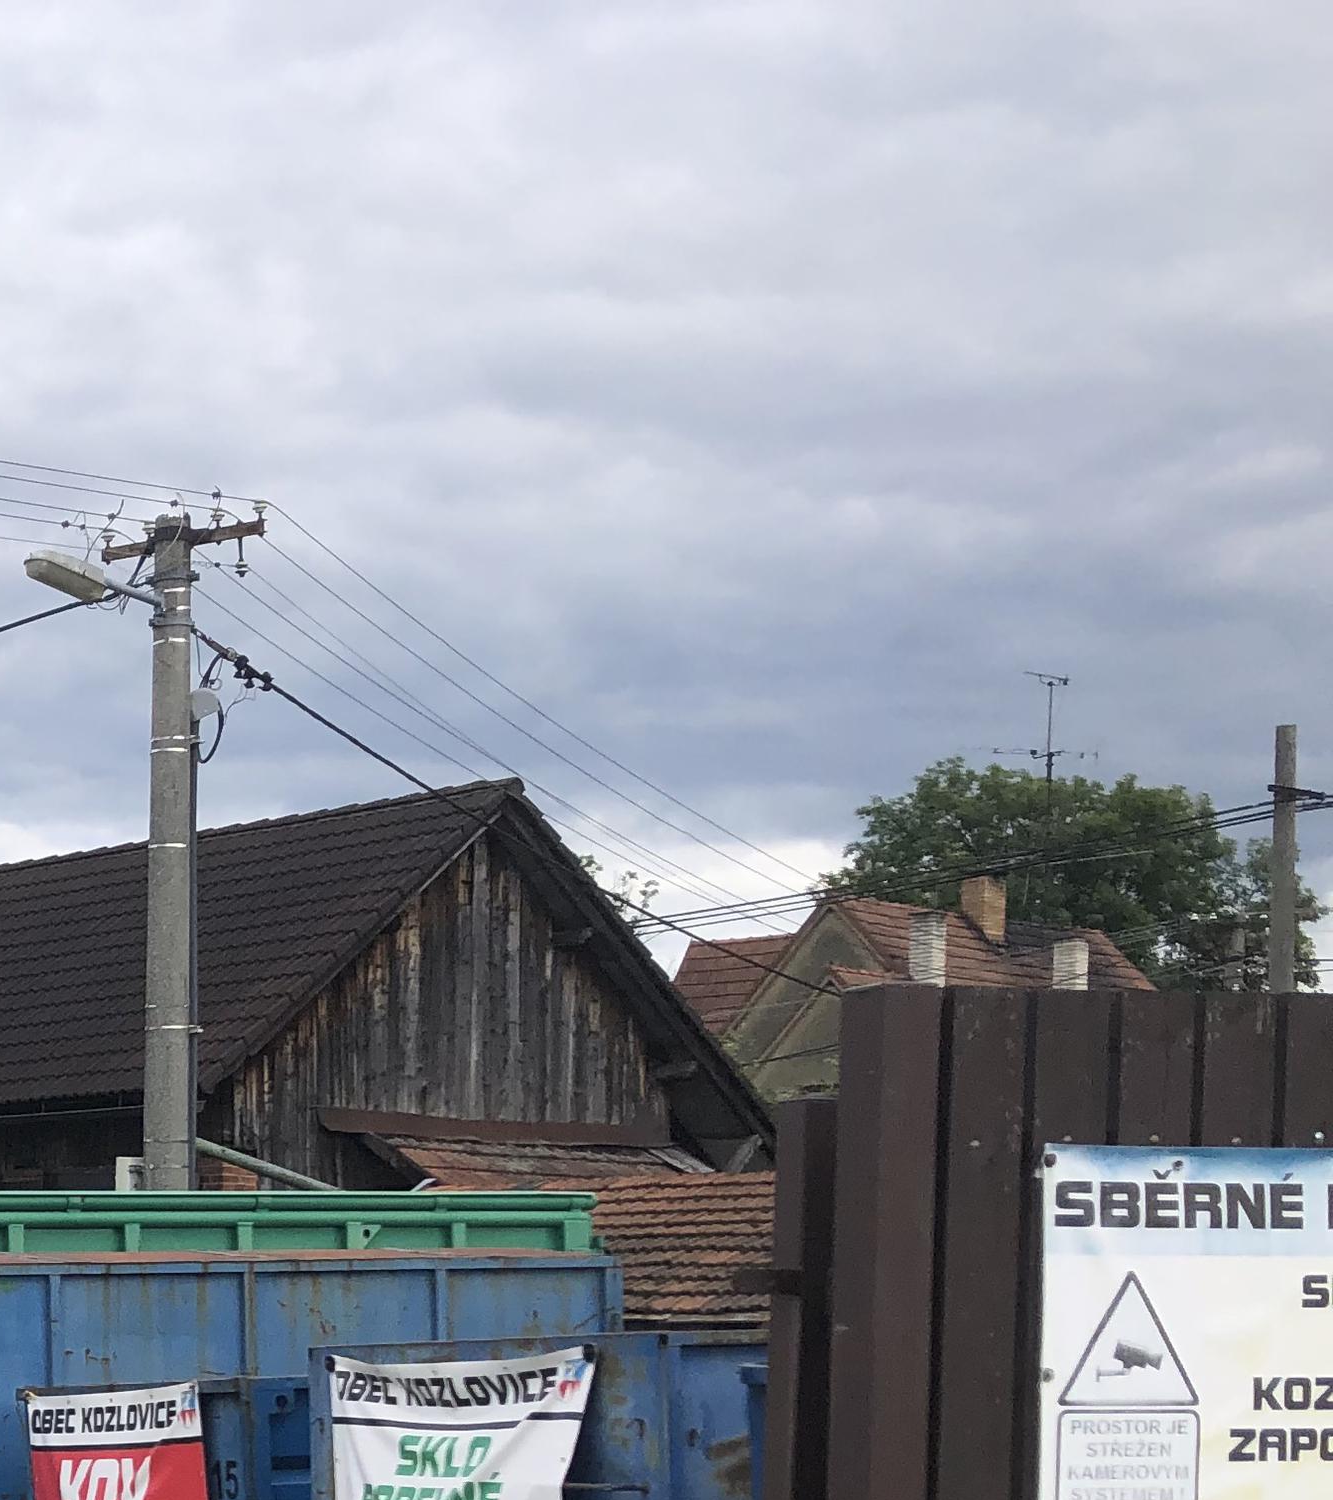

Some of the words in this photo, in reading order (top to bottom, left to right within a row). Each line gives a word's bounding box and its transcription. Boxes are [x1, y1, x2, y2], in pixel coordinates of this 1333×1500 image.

[1054, 1168, 1304, 1229] SBĚRNÉ
[1302, 1274, 1333, 1308] S
[335, 1370, 397, 1406] OBEC
[398, 1366, 558, 1408] KOZLOVICE
[1253, 1376, 1333, 1410] KOZ
[31, 1408, 75, 1434] OBEC
[81, 1399, 177, 1434] KOZLOVICE
[1070, 1419, 1161, 1435] PROSTOR
[1166, 1419, 1189, 1435] JE
[395, 1434, 493, 1478] SKLO
